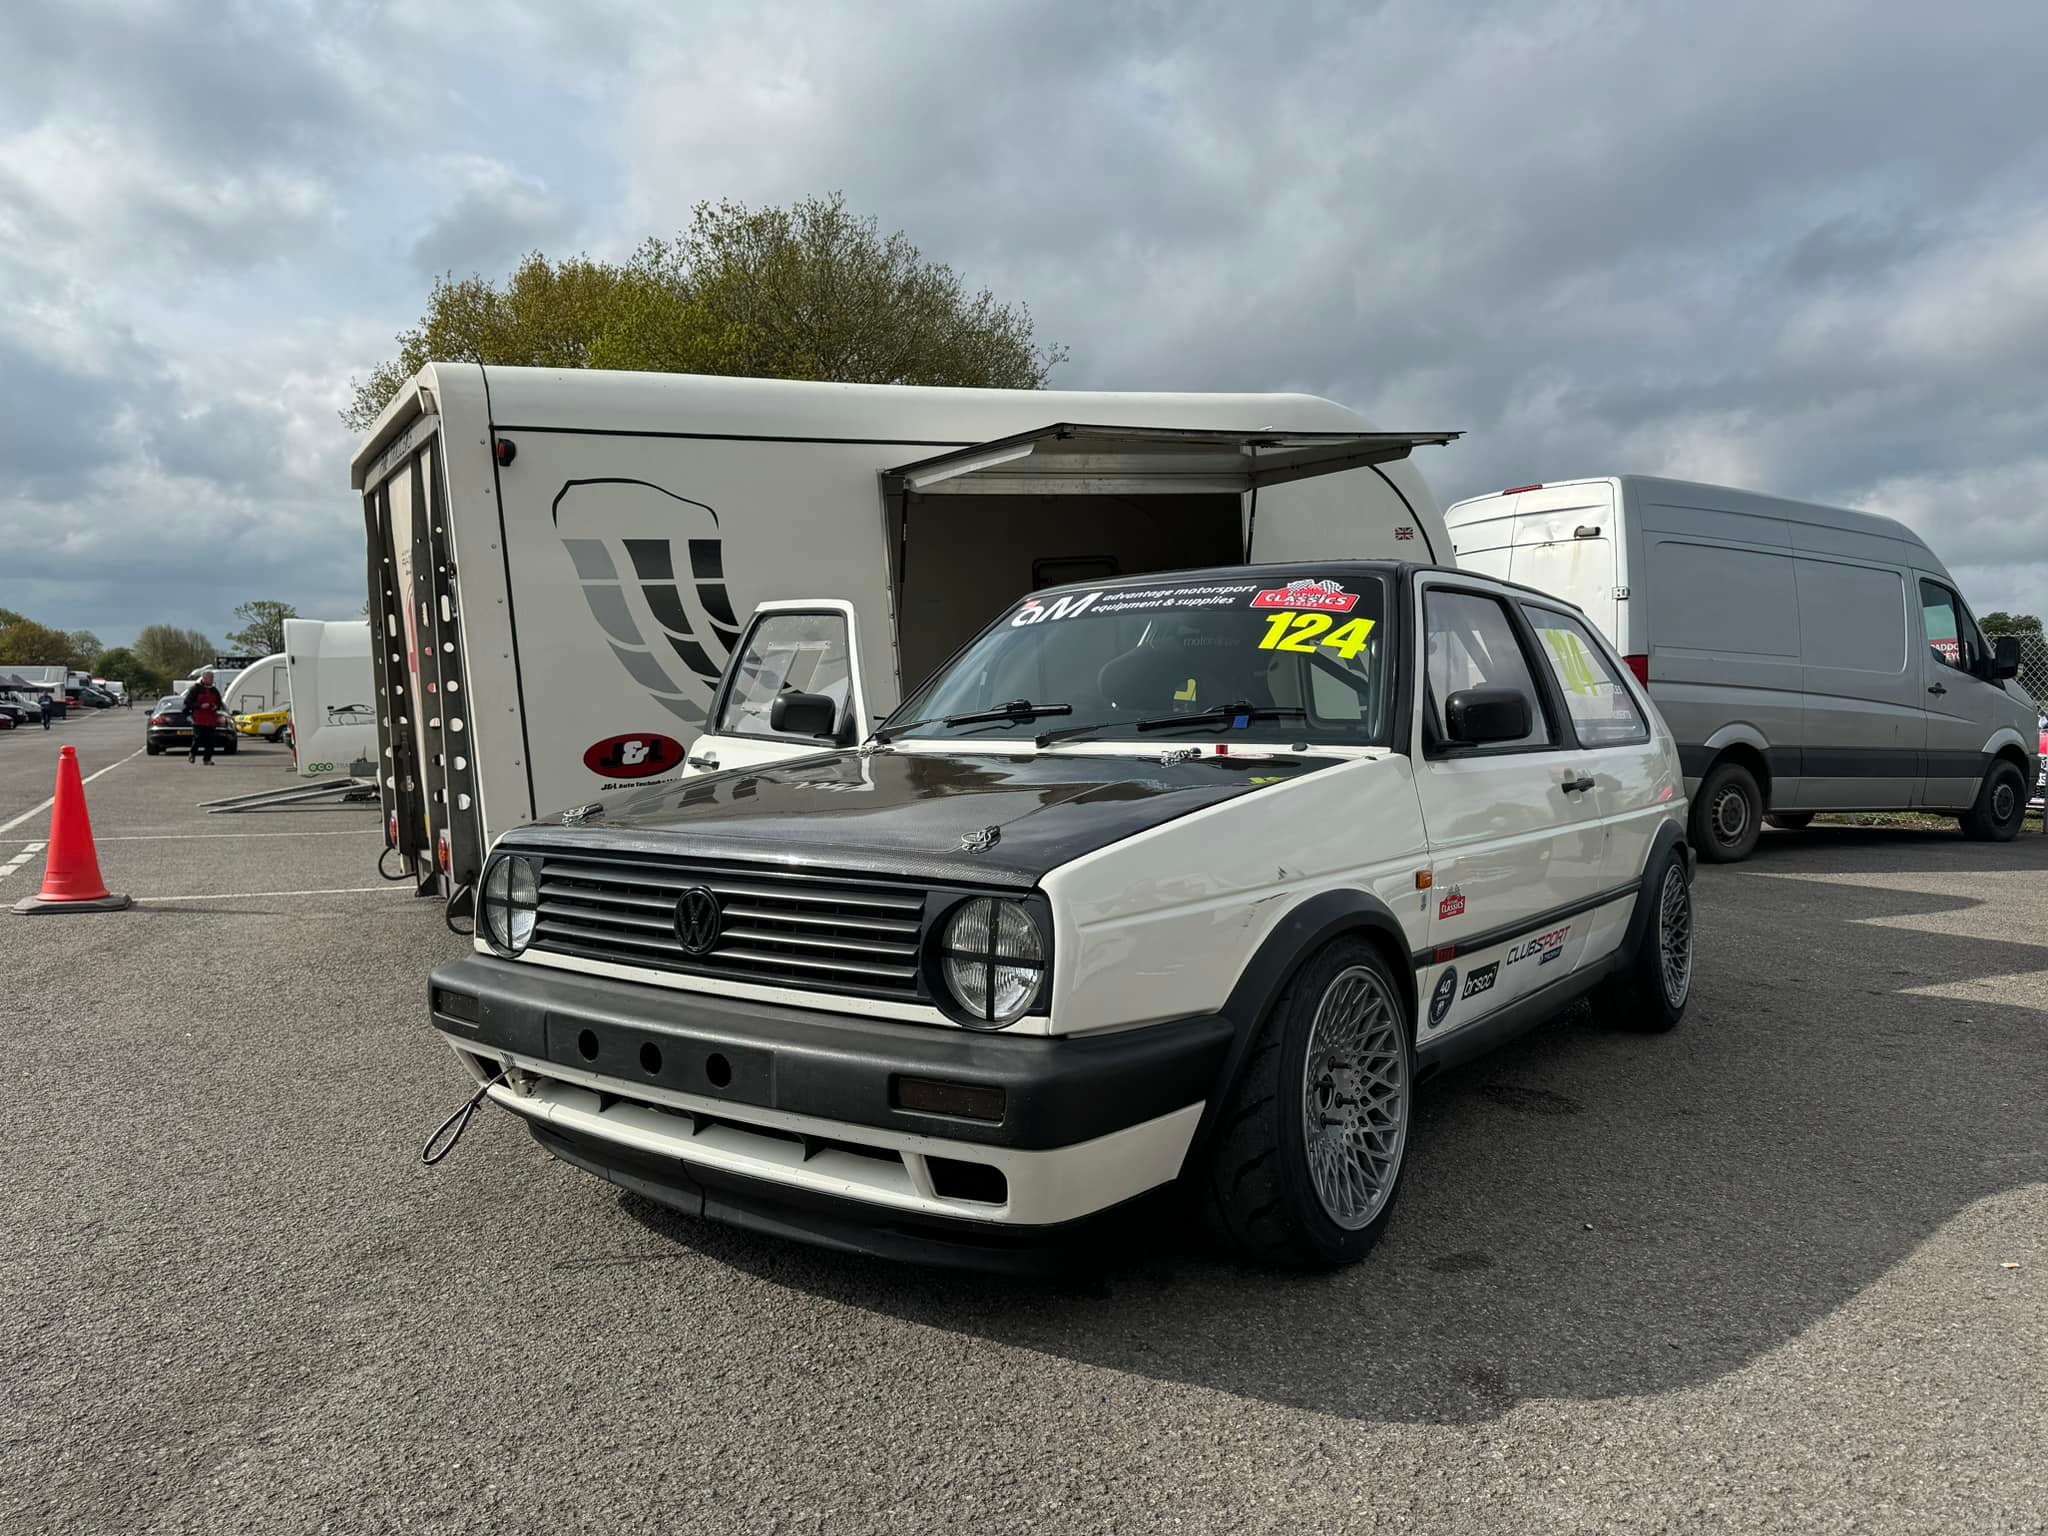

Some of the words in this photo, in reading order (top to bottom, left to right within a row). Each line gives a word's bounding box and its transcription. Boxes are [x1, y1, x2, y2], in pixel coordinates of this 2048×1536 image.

[1102, 589, 1174, 601] advantage
[1174, 585, 1257, 596] motorsport
[1265, 593, 1348, 605] CLASSICS
[1091, 598, 1161, 613] equipment
[1163, 598, 1175, 606] &
[1176, 596, 1235, 606] supplies
[1258, 612, 1376, 660] 124
[1506, 926, 1571, 965] CLUBSPORT
